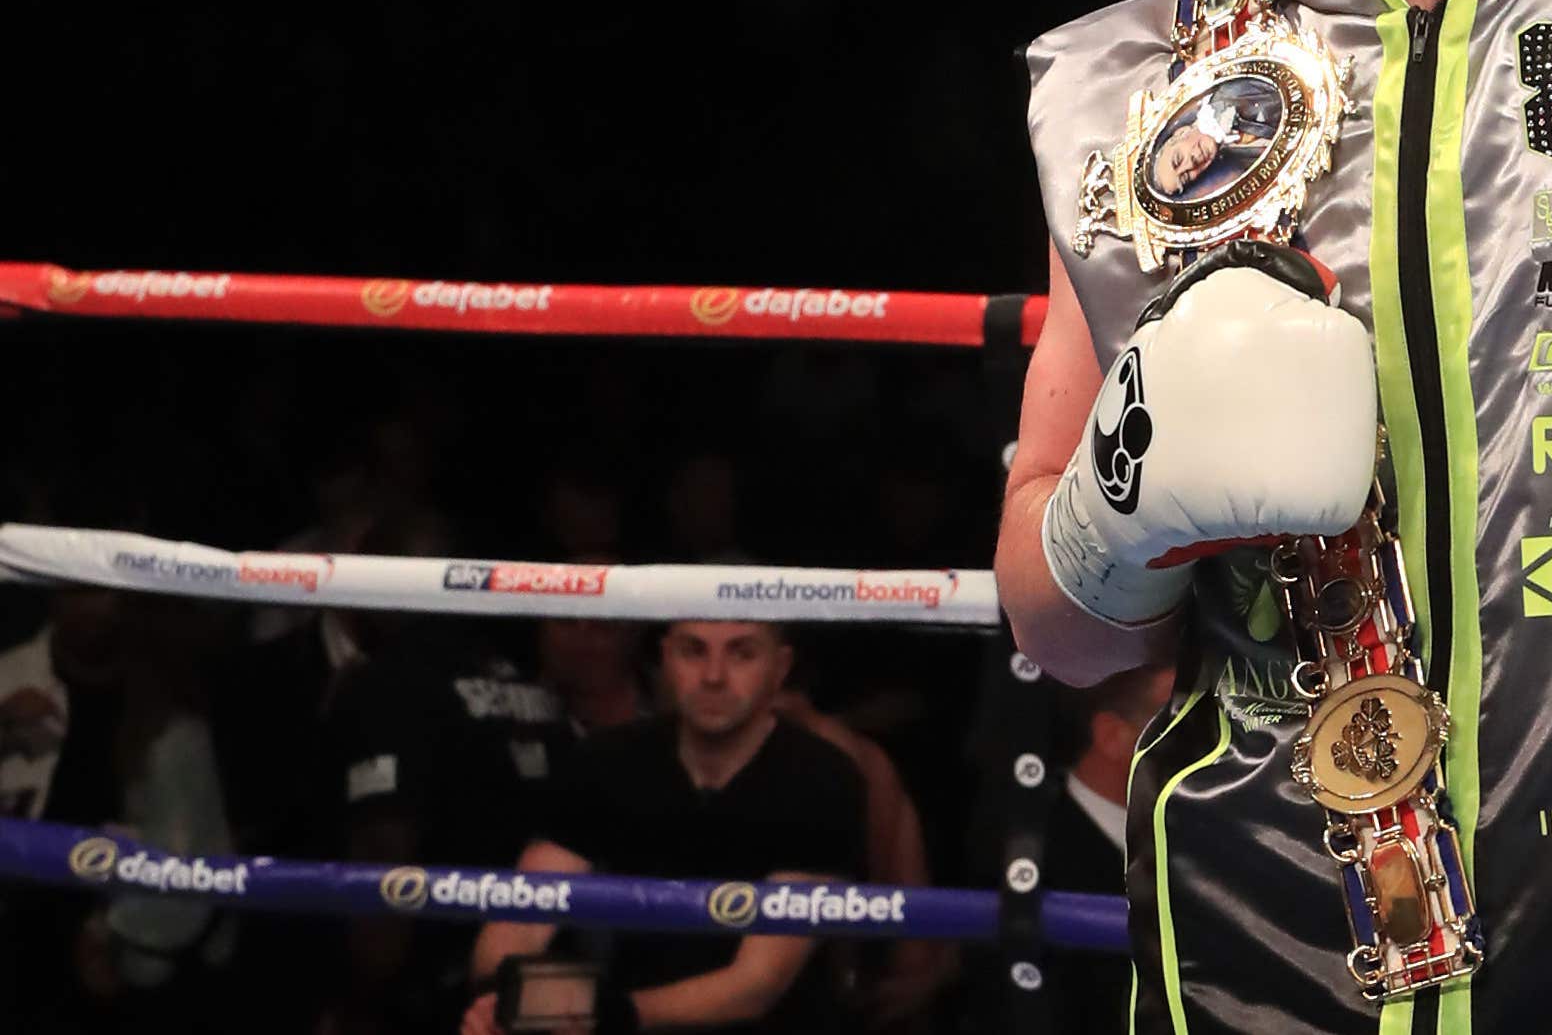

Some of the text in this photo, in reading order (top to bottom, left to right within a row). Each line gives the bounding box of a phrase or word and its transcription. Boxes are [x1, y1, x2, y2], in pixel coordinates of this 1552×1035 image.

[94, 271, 229, 302] dafabet
[414, 283, 551, 313] dafabet
[745, 289, 889, 321] dafabet
[718, 578, 940, 607] matchroomboxing
[118, 851, 248, 894] dafabet
[432, 872, 570, 911] dafabet
[762, 887, 904, 926] dafabet
